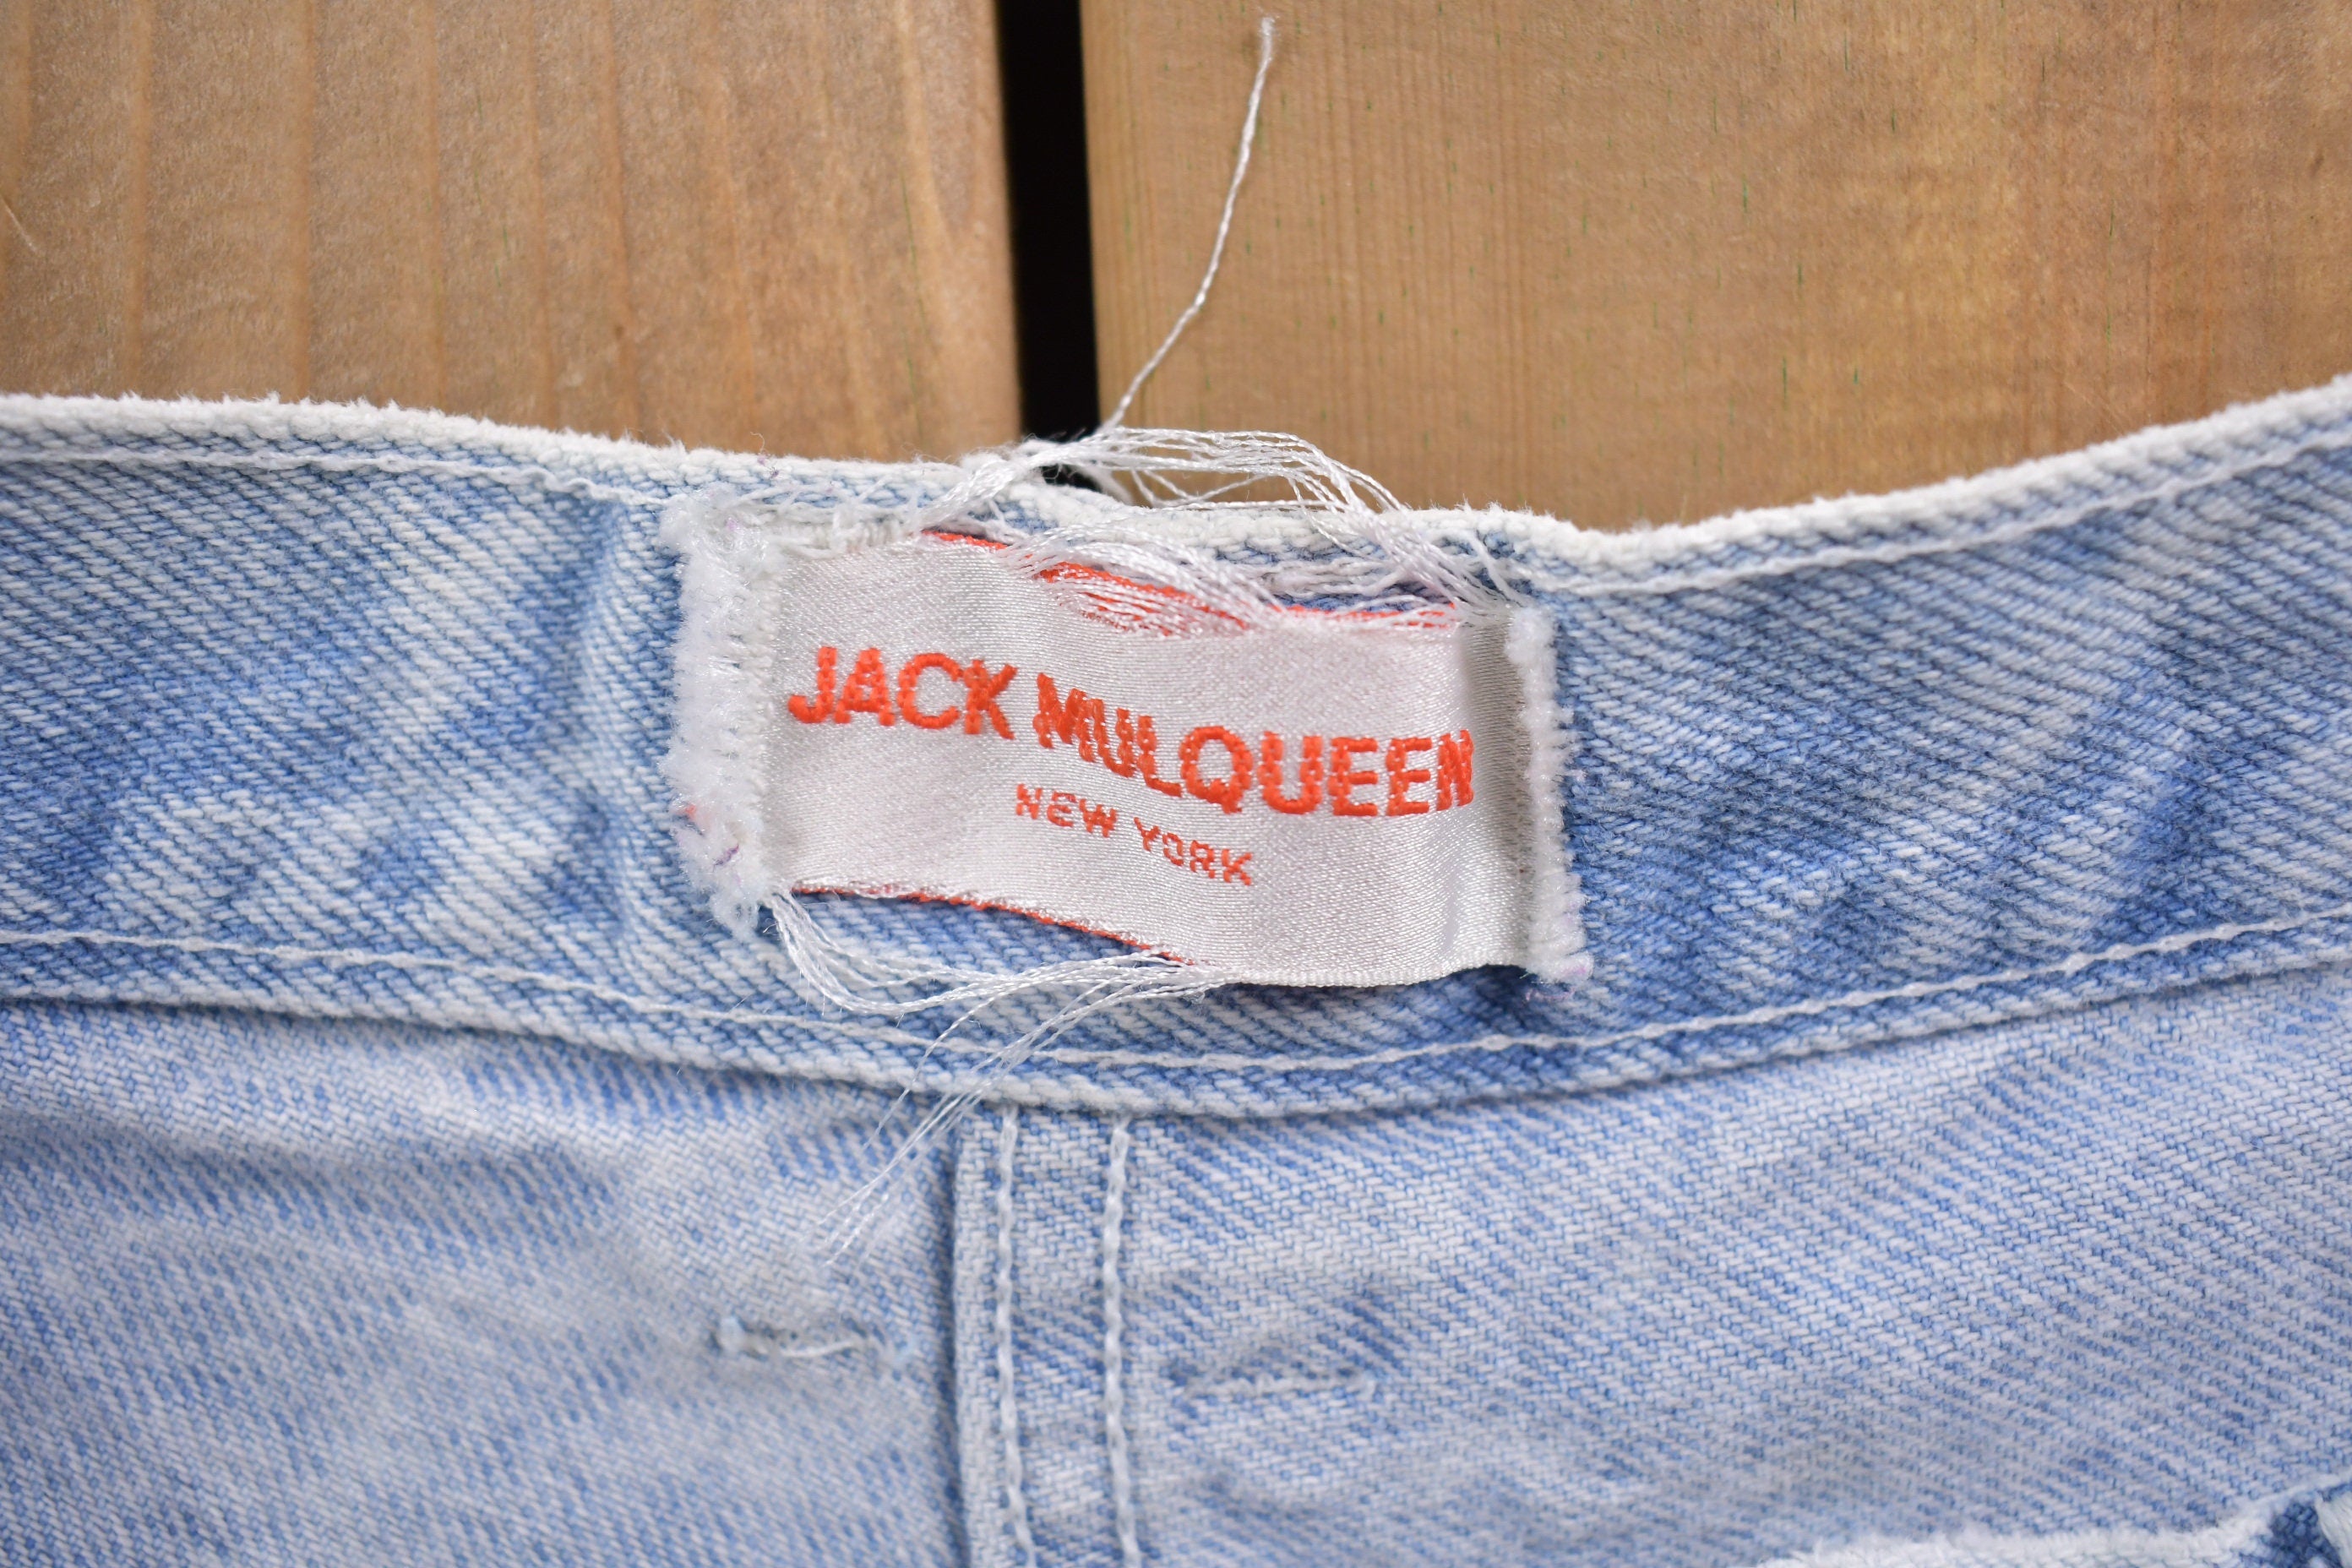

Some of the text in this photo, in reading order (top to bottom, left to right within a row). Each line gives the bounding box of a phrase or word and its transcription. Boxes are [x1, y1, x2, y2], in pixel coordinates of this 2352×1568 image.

[787, 645, 1475, 818] JACK MULQUEEN
[1015, 783, 1255, 886] NEW YORK
